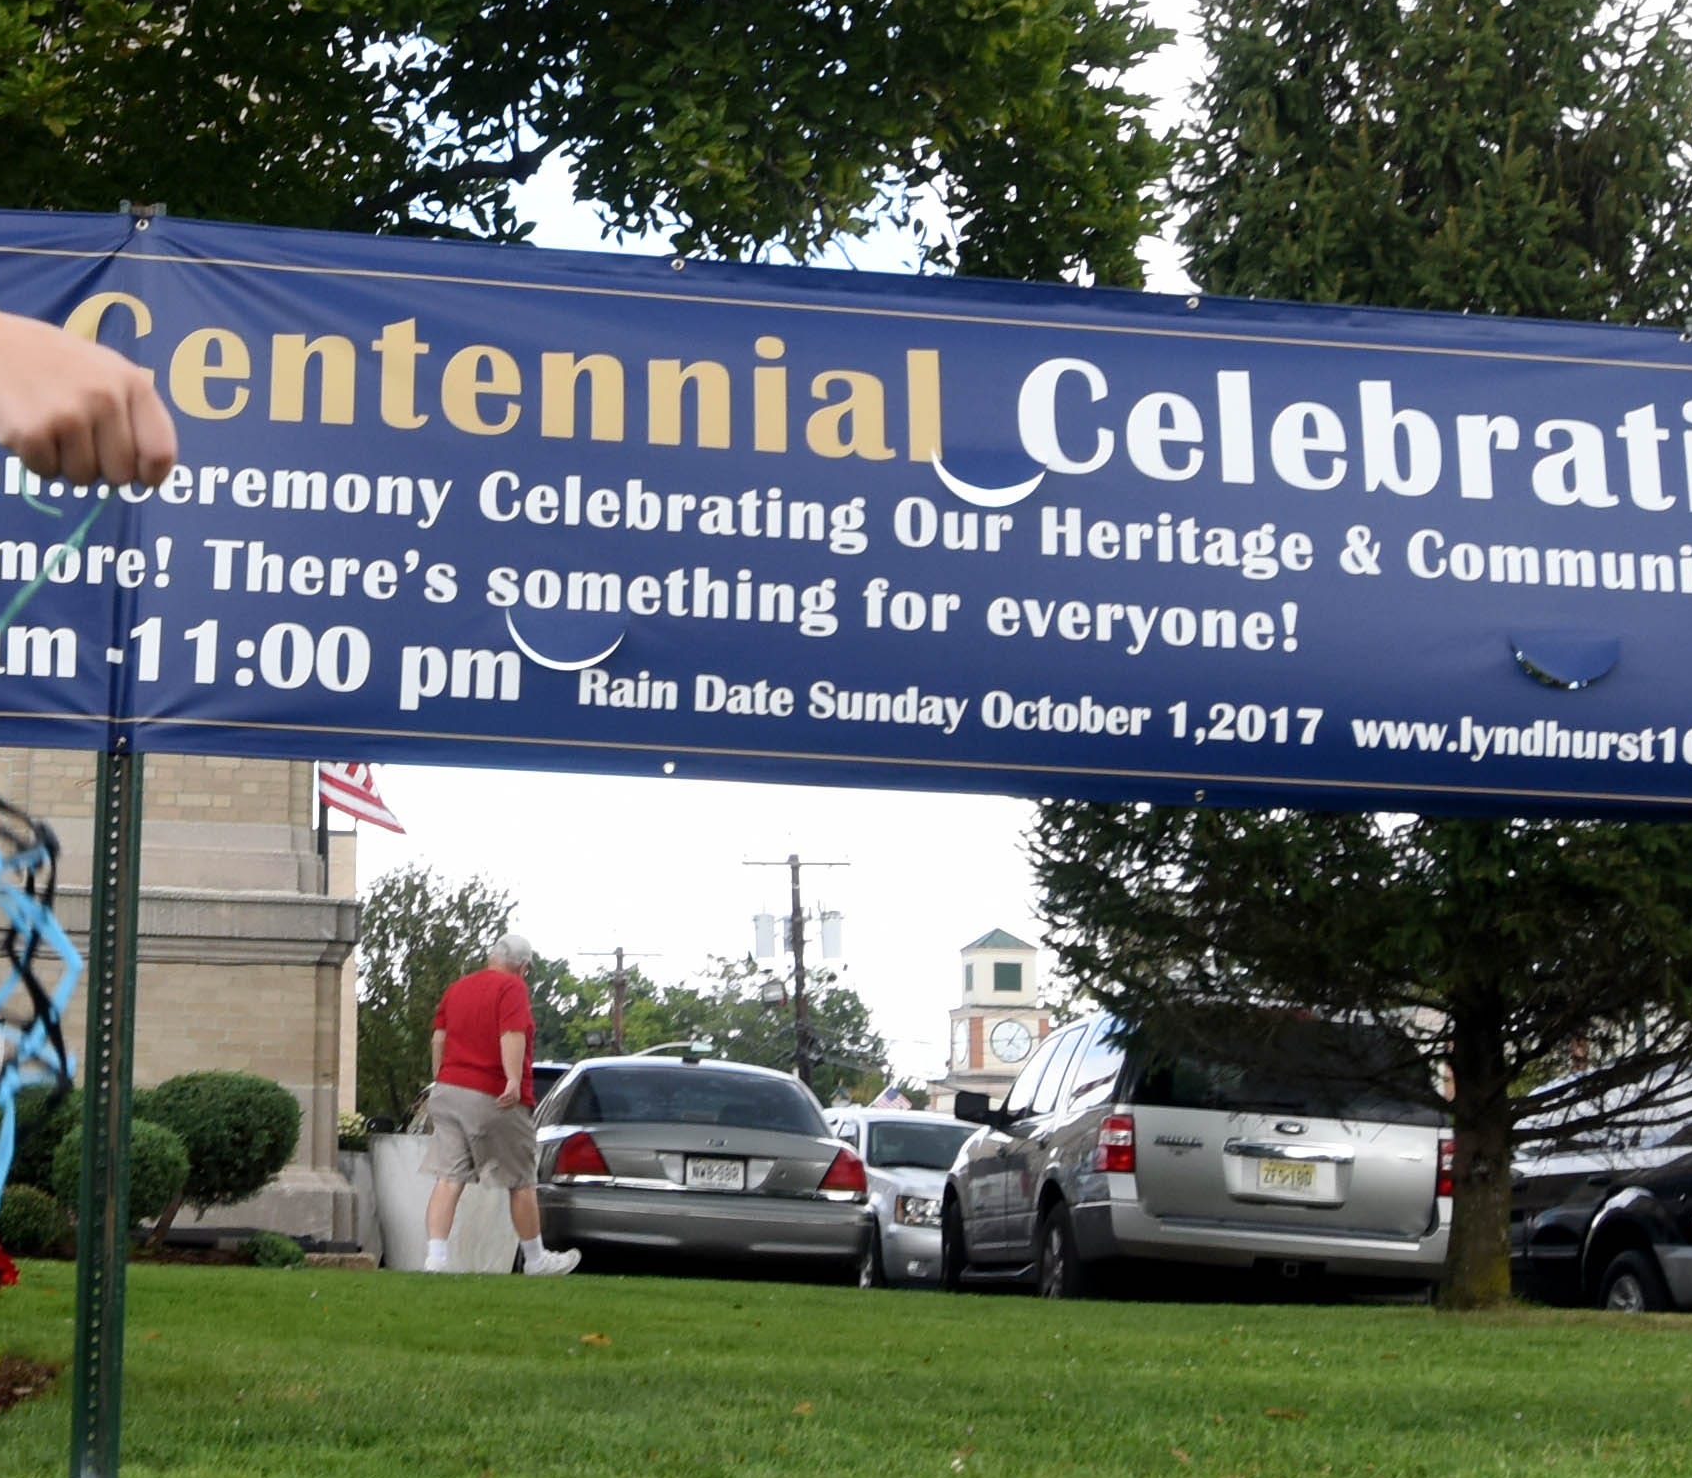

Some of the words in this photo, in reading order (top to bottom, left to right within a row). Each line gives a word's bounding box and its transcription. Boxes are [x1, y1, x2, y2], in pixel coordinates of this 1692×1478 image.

[478, 469, 868, 557] Celebrating
[893, 496, 1014, 554] Our
[1040, 505, 1315, 582] Heritage
[1338, 526, 1383, 577] &
[205, 537, 459, 606] There's
[486, 565, 839, 639] something
[863, 577, 961, 635] for
[986, 591, 1301, 658] everyone!
[398, 643, 522, 712] pm
[578, 668, 679, 713] Rain
[694, 673, 796, 718] Date
[808, 681, 969, 737] Sunday
[981, 687, 1152, 738] October
[1166, 704, 1325, 750] 1,2017
